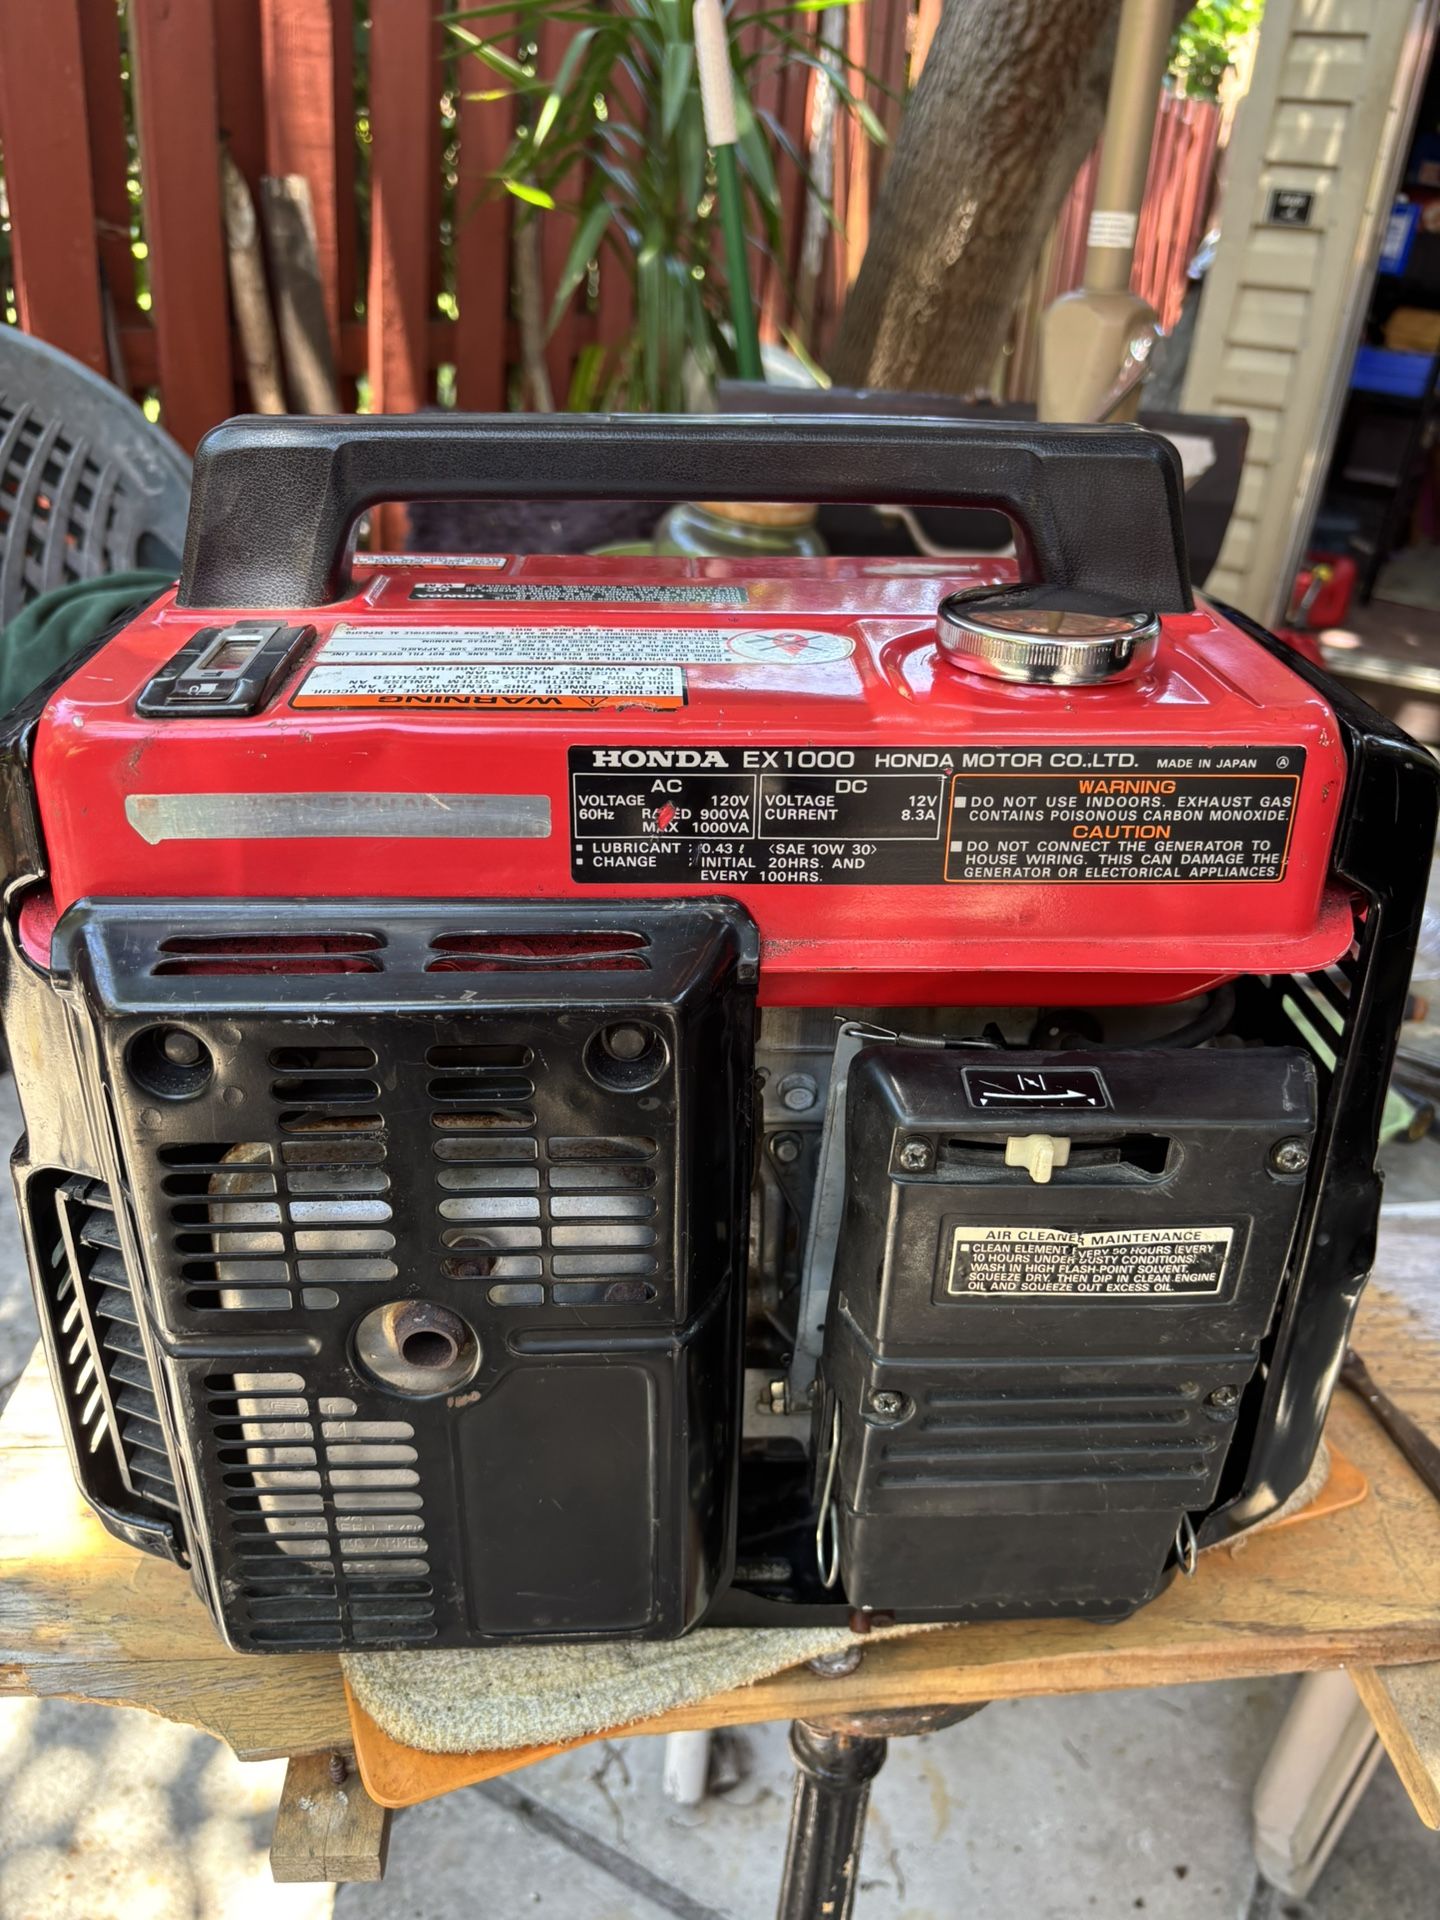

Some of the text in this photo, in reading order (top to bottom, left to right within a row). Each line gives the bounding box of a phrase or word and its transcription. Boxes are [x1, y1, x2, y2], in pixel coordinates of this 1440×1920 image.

[378, 695, 563, 705] WARNING
[592, 750, 855, 769] HONDA EX1000
[875, 753, 1139, 769] HONDA MOTOR CO.,LTD.
[1156, 758, 1258, 769] MADE IN JAPAN
[650, 780, 683, 793] AC
[835, 780, 868, 794] DC
[1079, 780, 1177, 794] WARNING
[578, 795, 750, 807] VOLTAGE 120V
[765, 795, 938, 807] VOLTAGE 12V
[970, 796, 1292, 808] DO NOT USE INDOORS. EXHAUST GAS
[579, 808, 750, 821] 60Hz RED 900VA
[764, 809, 936, 822] CURRENT 8.3A
[969, 810, 1290, 822] CONTAINS POISONOUS CARBON MONOXIDE.
[642, 821, 750, 834] MX 1000VA
[1072, 825, 1171, 839] CAUTION
[592, 842, 681, 854] LUBRICANT
[701, 843, 733, 855] 0.43
[811, 844, 848, 855] 10W
[966, 840, 1271, 852] DO NOT CONNECT THE GENERATOR TO
[592, 855, 866, 870] CHANGE INITIAL 20HRS. AND
[965, 853, 1280, 866] HOUSE WIRING. THIS CAN DAMAGE THE
[700, 870, 823, 883] EVERY 100HRS.
[964, 866, 1279, 879] GENERATOR OR ELECTORICAL APPLIANCES.
[985, 1230, 1202, 1246] AIR CLEANER MAINTENANCE
[972, 1243, 1011, 1253] CLEAN
[1014, 1244, 1068, 1254] ELEMENT
[1130, 1246, 1172, 1255] HOURS
[1174, 1244, 1215, 1254] (EVERY
[972, 1253, 985, 1262] 10
[988, 1254, 1030, 1263] HOURS
[1034, 1254, 1075, 1264] UNDER
[970, 1263, 1189, 1274] WASH IN HIGH FLASH-POINT SOLVENT.
[968, 1272, 1022, 1282] SQUEEZE
[1057, 1274, 1088, 1283] THEN
[1092, 1274, 1113, 1283] DIP
[1116, 1274, 1129, 1283] IN
[1133, 1273, 1171, 1283] CLEAN
[1174, 1272, 1217, 1283] ENGINE
[967, 1282, 1175, 1292] OIL AND SQUEEZE OUT EXCESS OIL.
